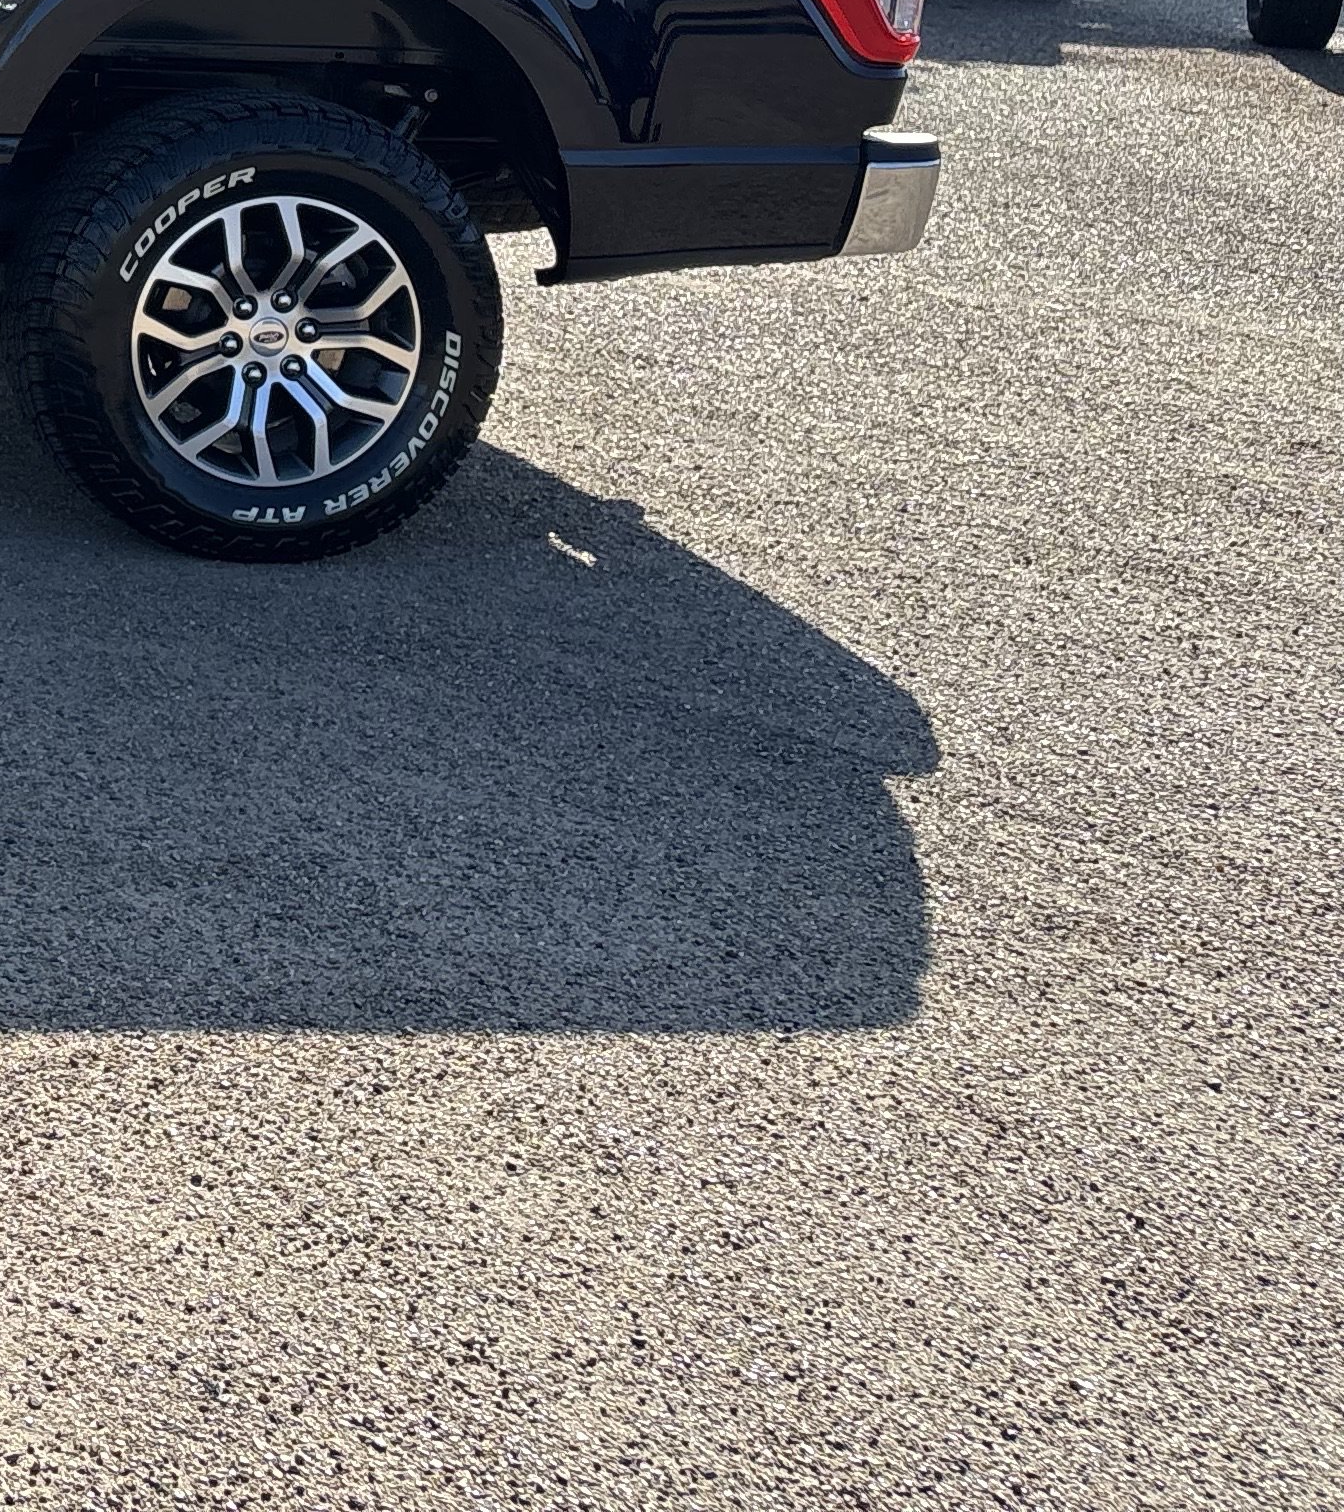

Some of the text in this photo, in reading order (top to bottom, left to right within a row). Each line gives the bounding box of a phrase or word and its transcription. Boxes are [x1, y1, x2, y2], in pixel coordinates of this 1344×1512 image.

[120, 167, 256, 281] COOPER
[231, 330, 462, 523] DISCOVERER ATP
